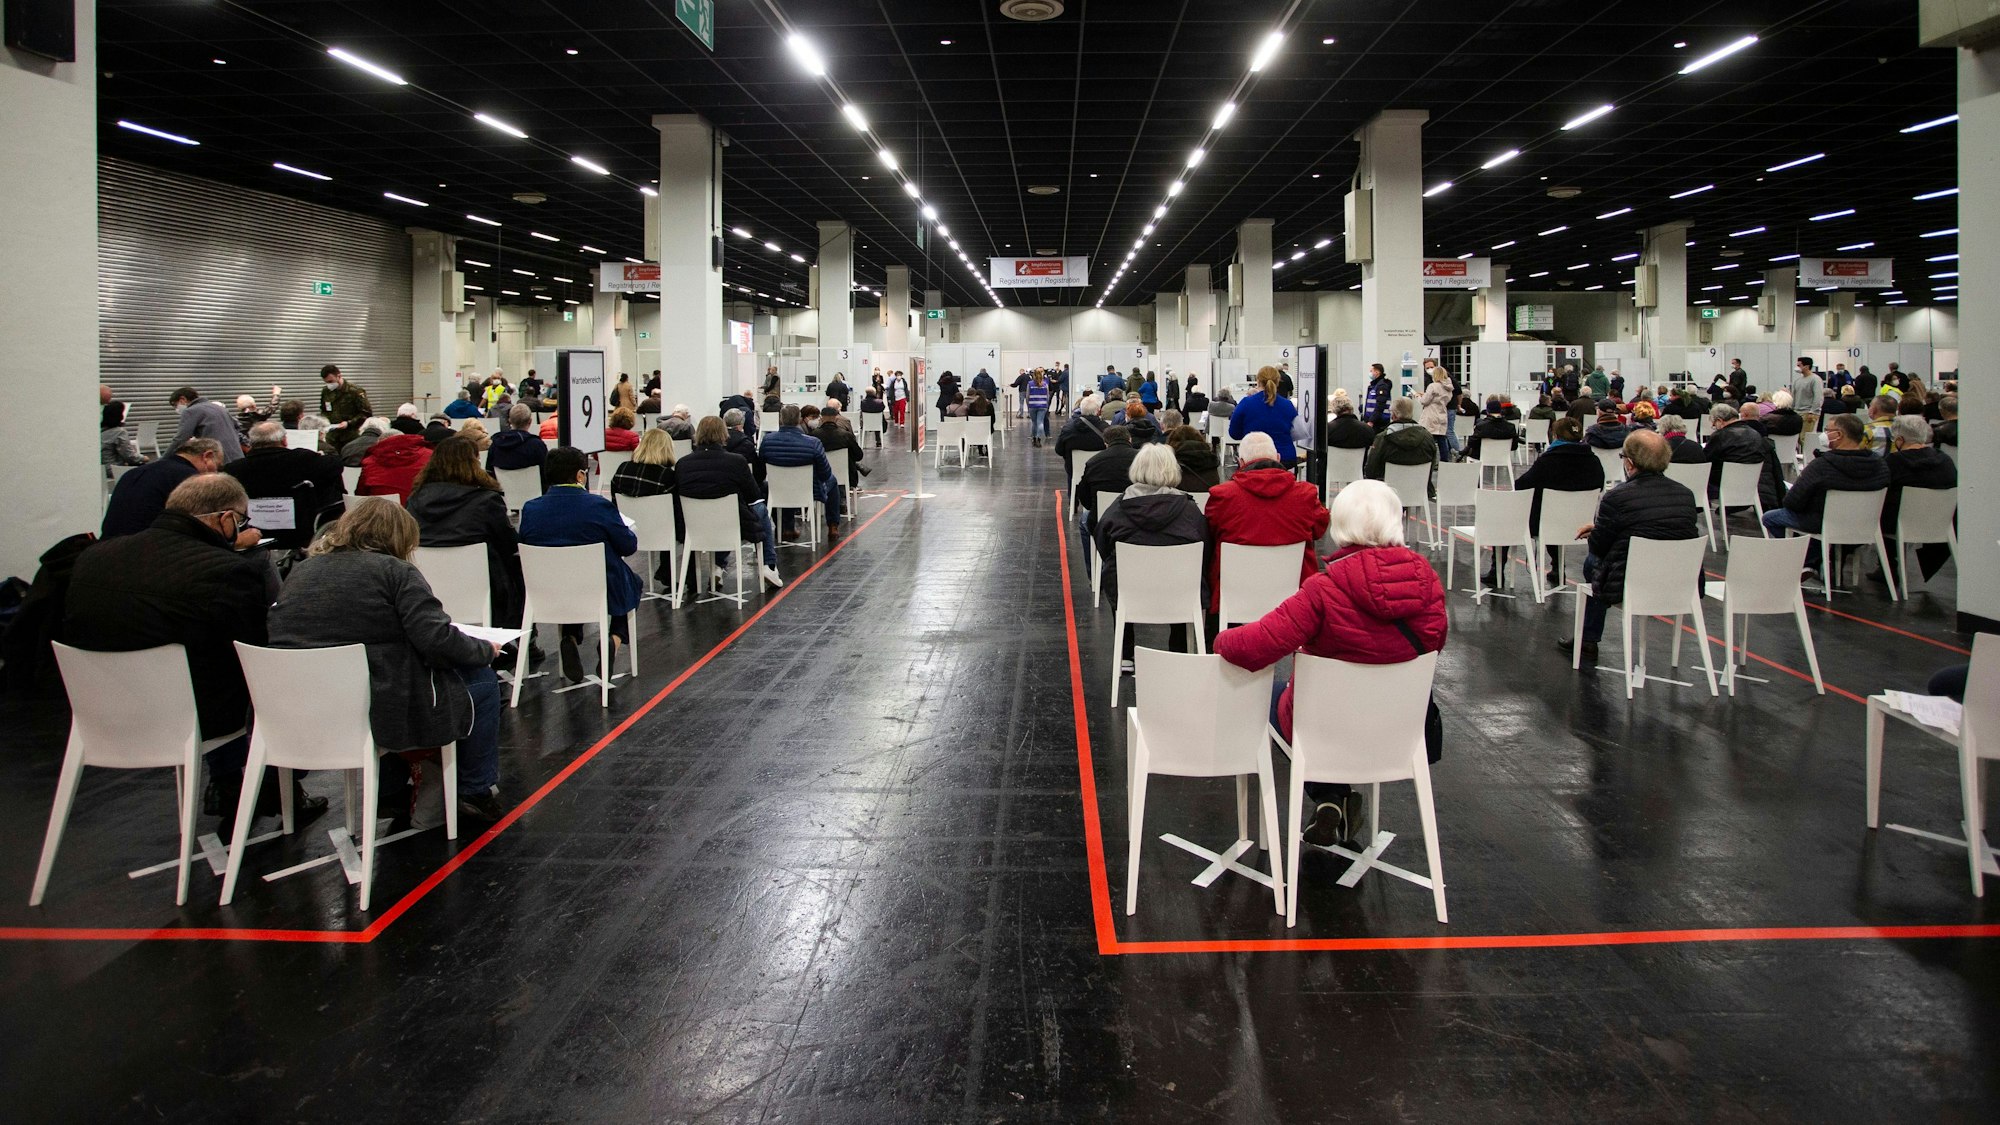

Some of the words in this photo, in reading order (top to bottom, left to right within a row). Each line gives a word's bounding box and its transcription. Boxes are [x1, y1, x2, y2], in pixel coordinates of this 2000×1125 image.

[999, 277, 1039, 285] Registrierung
[1045, 276, 1080, 285] Registration
[1807, 277, 1845, 285] Registrierung
[608, 282, 645, 290] Registrierung
[651, 281, 661, 289] Re
[842, 349, 848, 359] 3
[988, 349, 994, 358] 4
[1136, 348, 1142, 358] 5
[1282, 348, 1289, 357] 6
[1427, 348, 1433, 357] 7
[1571, 348, 1576, 357] 8
[1710, 348, 1716, 357] 9
[1848, 348, 1860, 357] 10
[571, 376, 601, 385] Wartebereich
[1303, 389, 1310, 423] 8
[582, 395, 592, 428] 9
